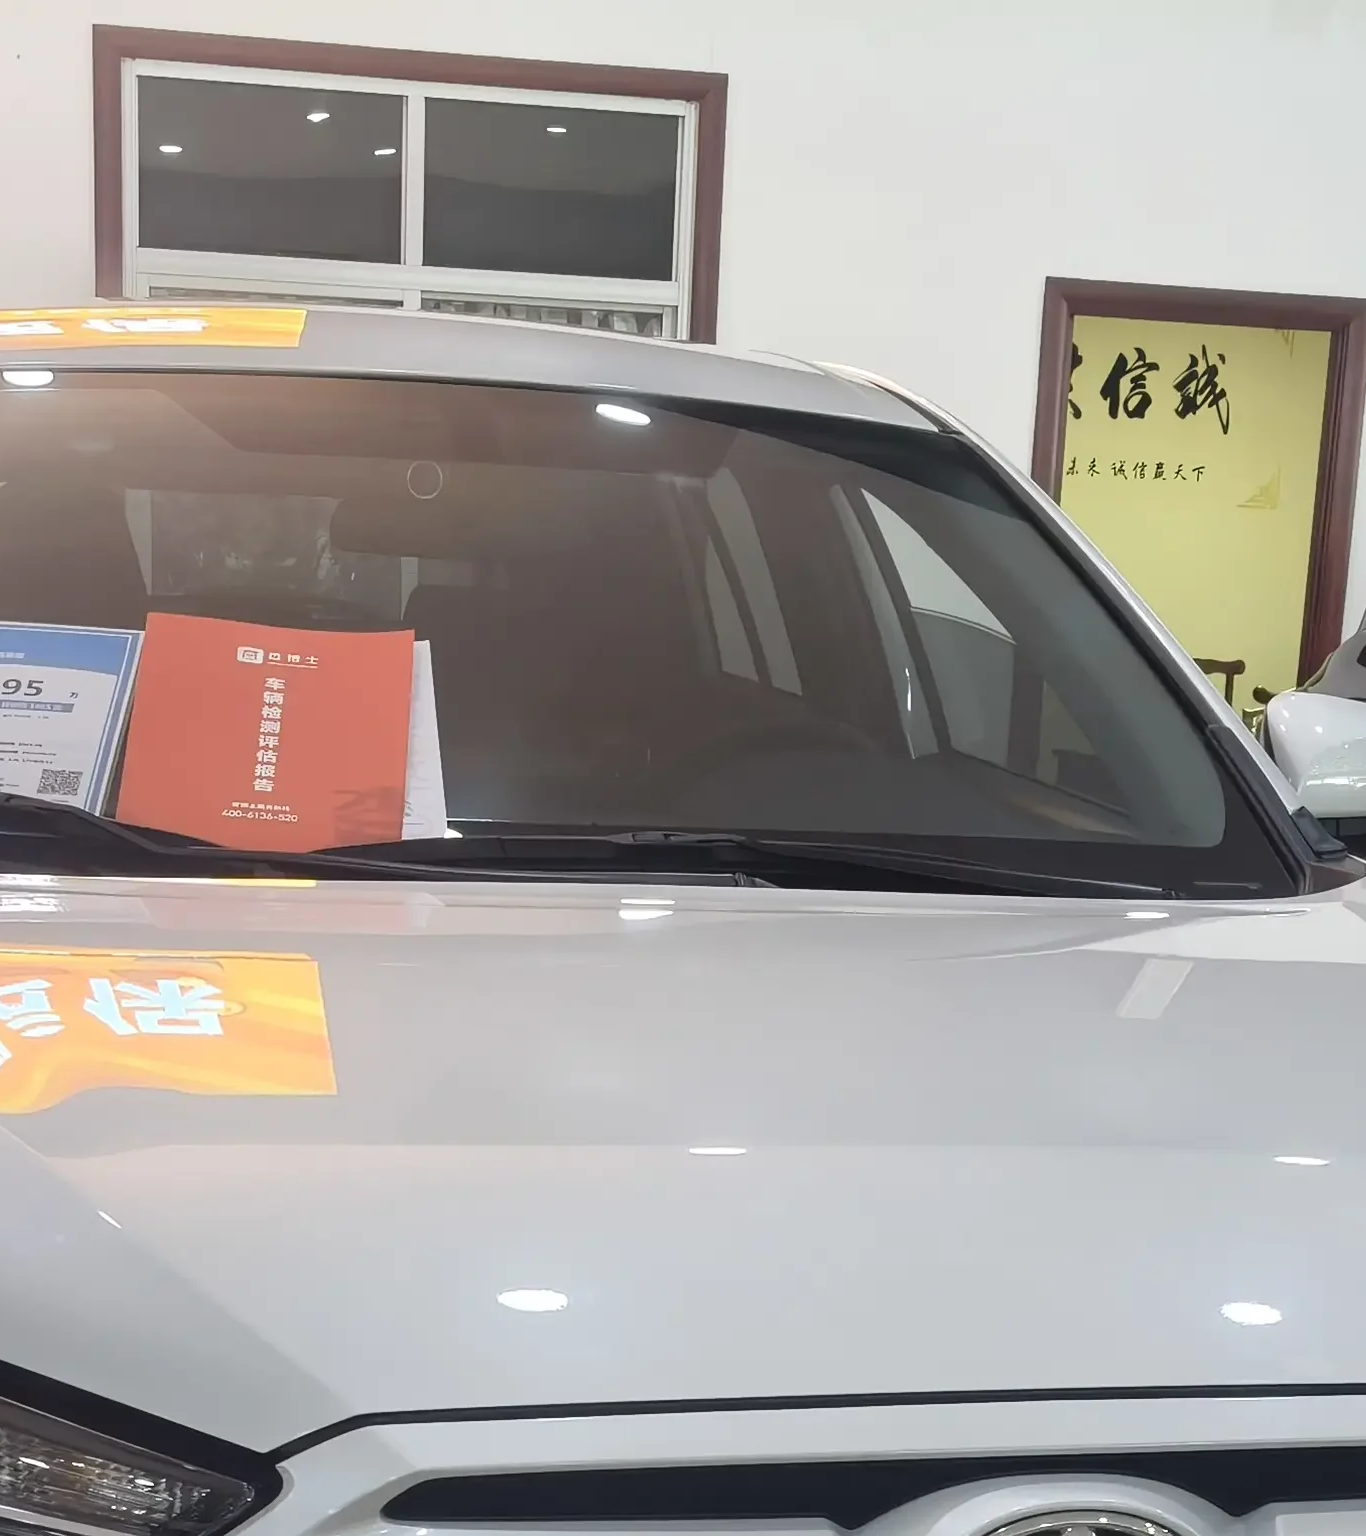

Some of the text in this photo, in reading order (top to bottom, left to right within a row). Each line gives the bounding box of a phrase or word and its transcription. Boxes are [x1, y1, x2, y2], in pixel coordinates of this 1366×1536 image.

[253, 677, 286, 792] 车辆检测评估报告
